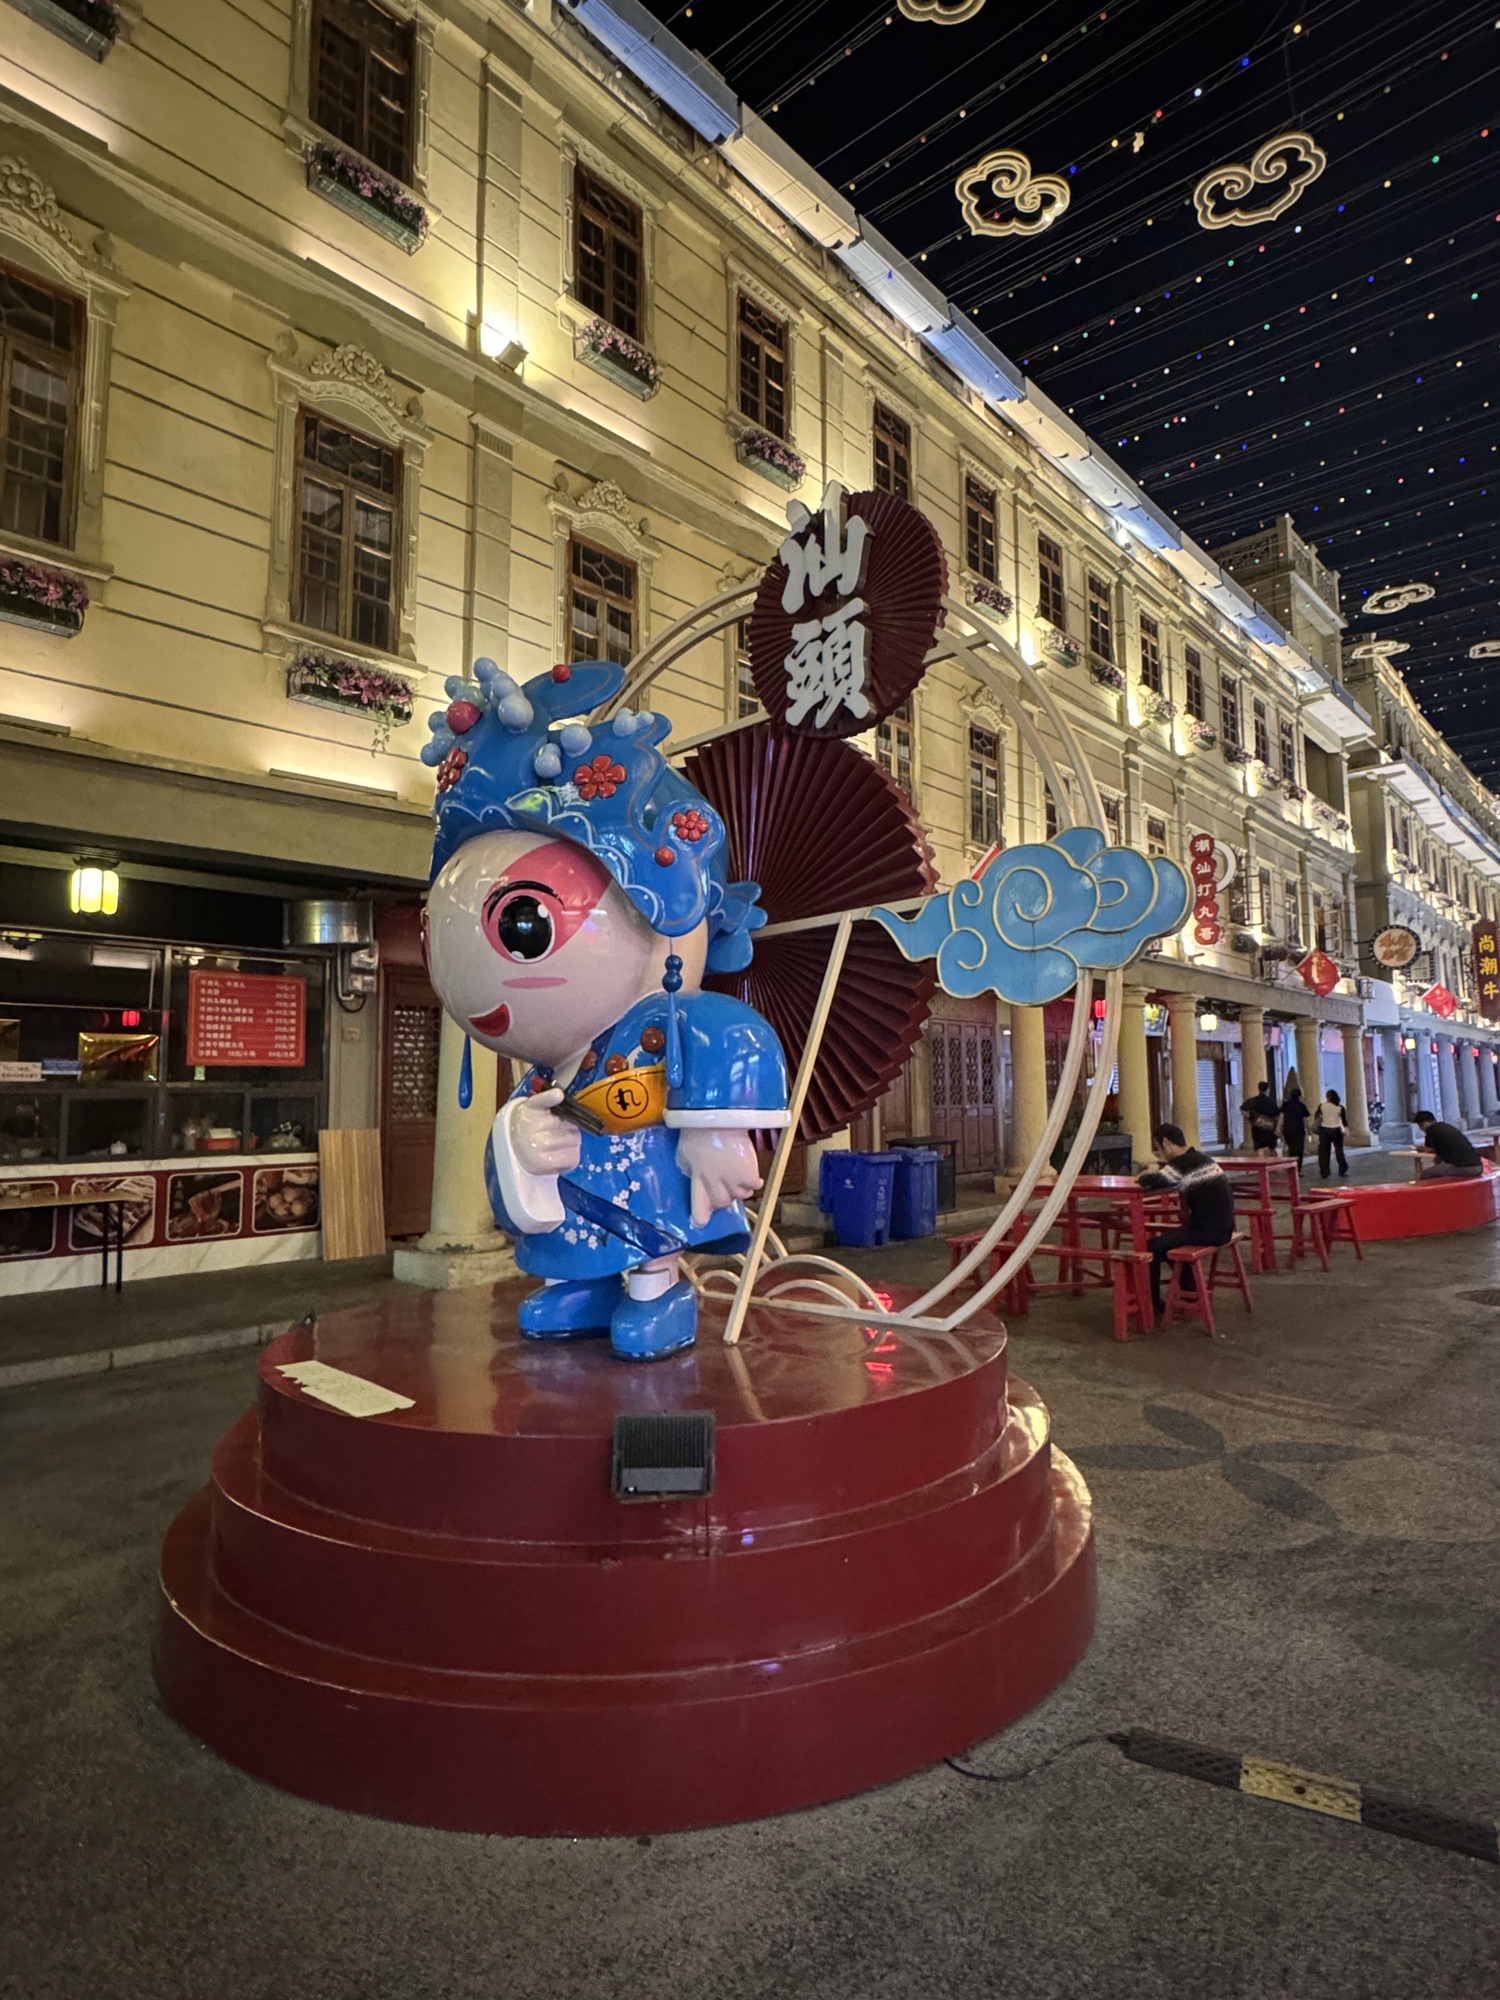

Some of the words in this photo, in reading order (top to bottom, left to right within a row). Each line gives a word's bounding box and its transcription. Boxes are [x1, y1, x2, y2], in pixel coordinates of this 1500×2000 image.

[1194, 839, 1215, 940] 潮汕打丸哥
[1478, 934, 1500, 1000] 尚潮牛
